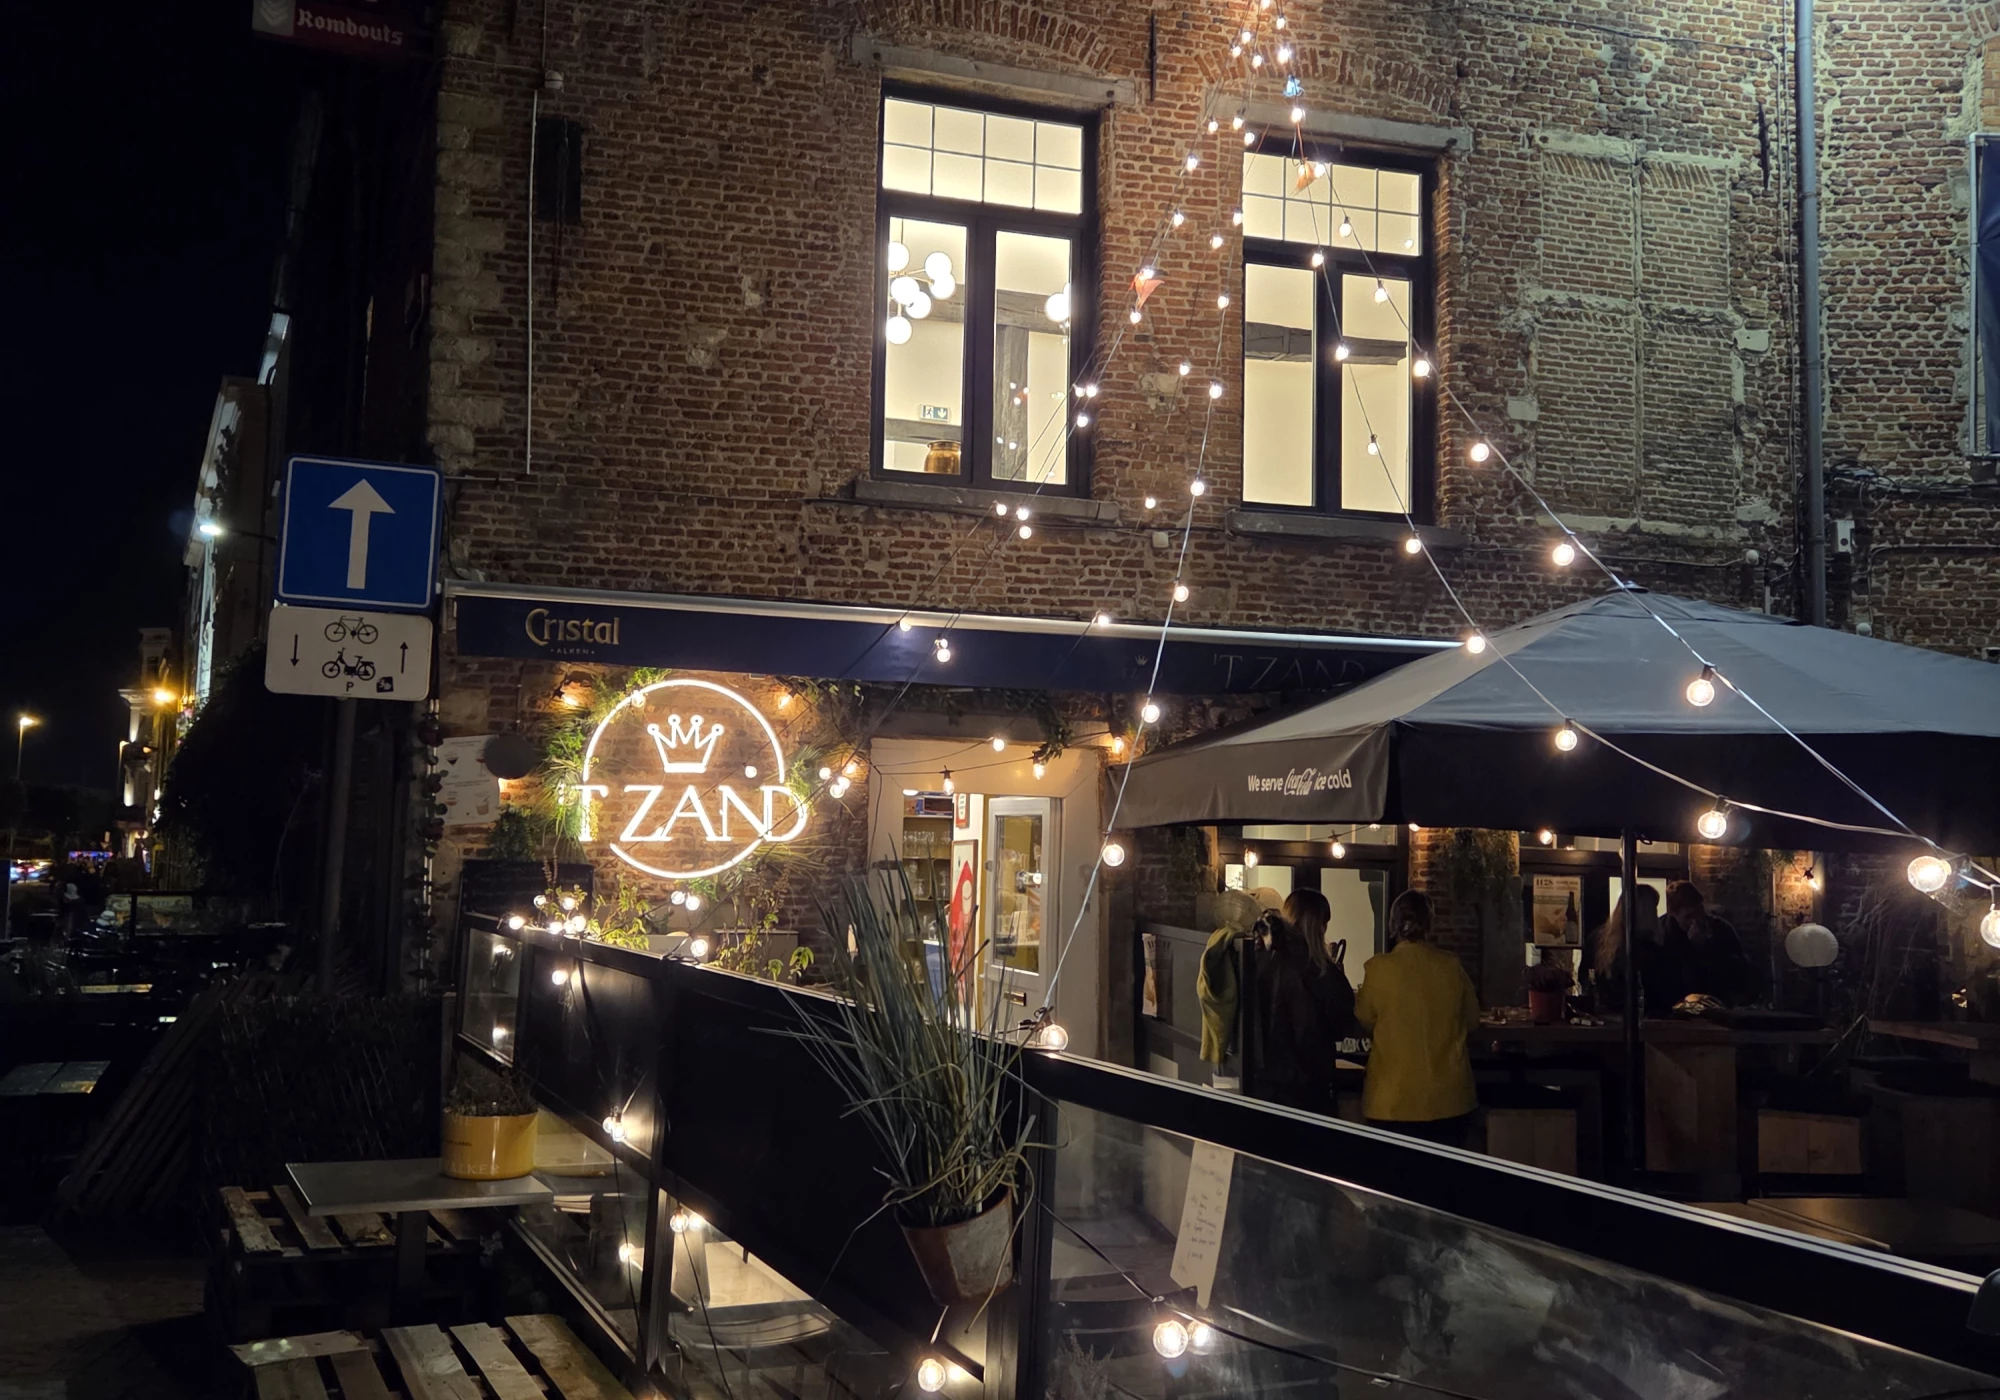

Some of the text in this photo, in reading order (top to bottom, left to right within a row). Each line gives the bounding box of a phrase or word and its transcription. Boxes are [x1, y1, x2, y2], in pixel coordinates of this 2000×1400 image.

[296, 8, 404, 46] Rombouts
[525, 608, 621, 647] Cristal
[346, 681, 354, 692] P
[1247, 775, 1260, 792] We
[1261, 776, 1283, 792] serve
[1314, 772, 1327, 790] ice
[1327, 768, 1352, 790] cold
[619, 784, 809, 842] ZAND
